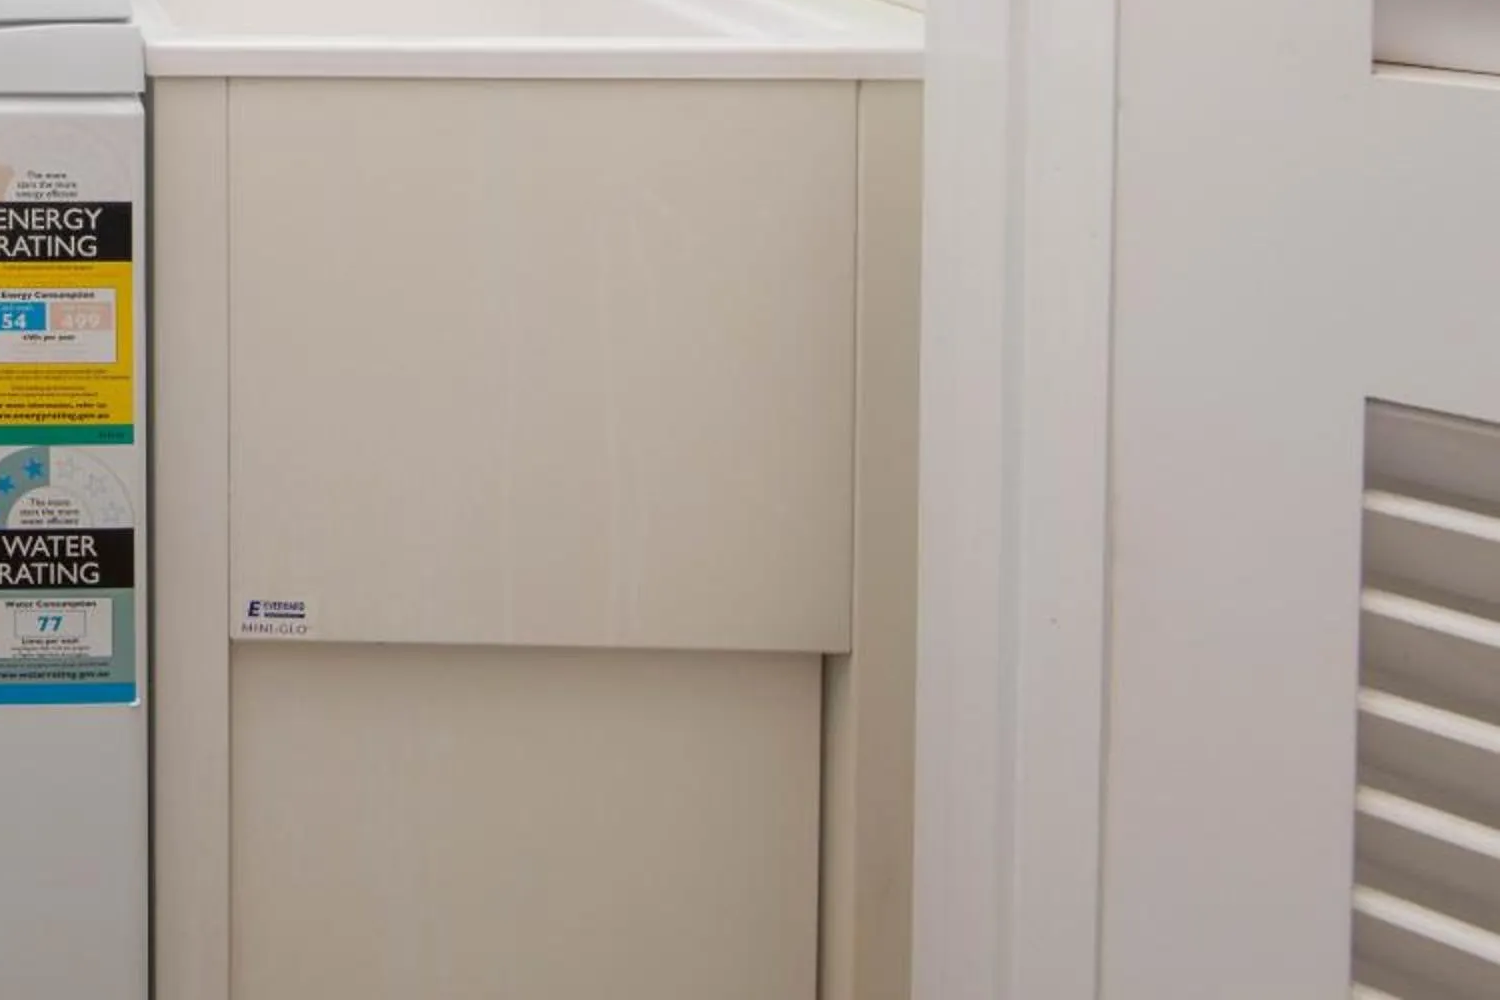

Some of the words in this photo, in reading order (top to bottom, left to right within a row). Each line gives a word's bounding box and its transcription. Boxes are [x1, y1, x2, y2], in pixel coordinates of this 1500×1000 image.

[1, 313, 26, 329] 54
[1, 535, 98, 558] WATER
[37, 615, 64, 632] 77
